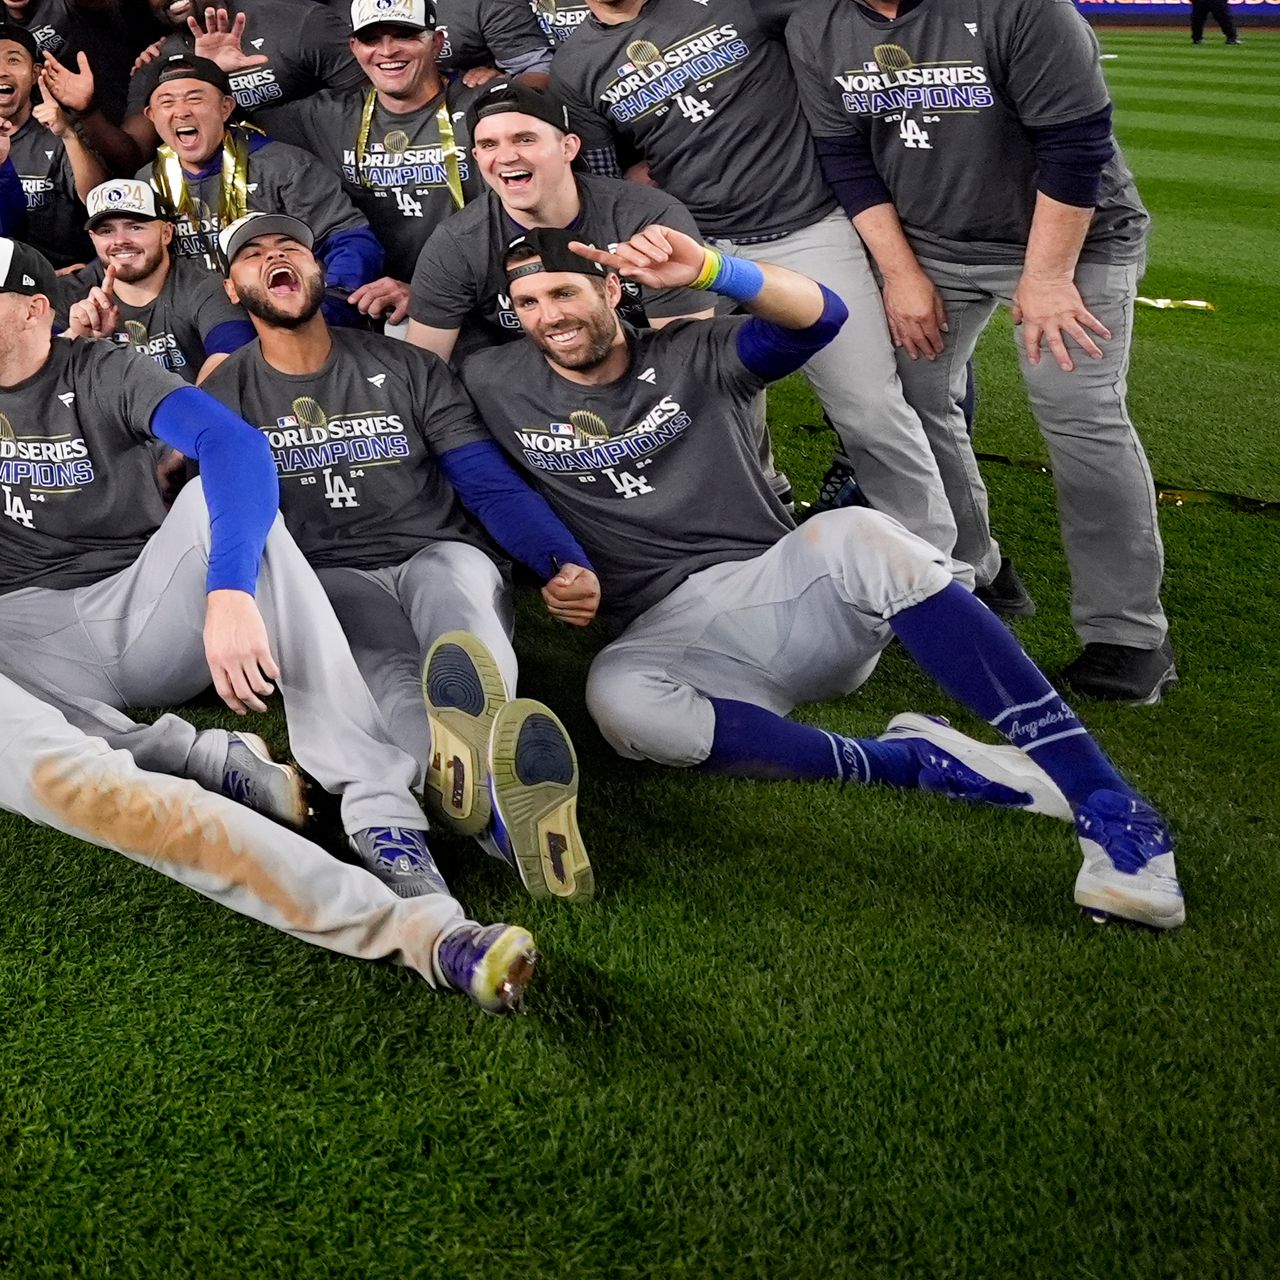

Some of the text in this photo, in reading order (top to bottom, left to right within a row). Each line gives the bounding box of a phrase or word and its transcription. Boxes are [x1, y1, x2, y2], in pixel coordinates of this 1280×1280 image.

[599, 24, 738, 106] WORLD SERIES
[608, 37, 750, 124] CHAMPIONS
[908, 65, 988, 86] SERIES
[697, 81, 715, 93] 24
[672, 92, 715, 124] LA
[899, 112, 933, 150] LA
[326, 414, 404, 440] SERIES
[523, 410, 692, 470] CHAMPIONS
[16, 437, 89, 465] SERIES
[269, 435, 410, 472] HAMPIONS
[299, 468, 365, 486] 20 24
[323, 468, 359, 508] LA
[601, 468, 656, 500] LA
[3, 484, 36, 529] LA
[30, 493, 45, 502] 24
